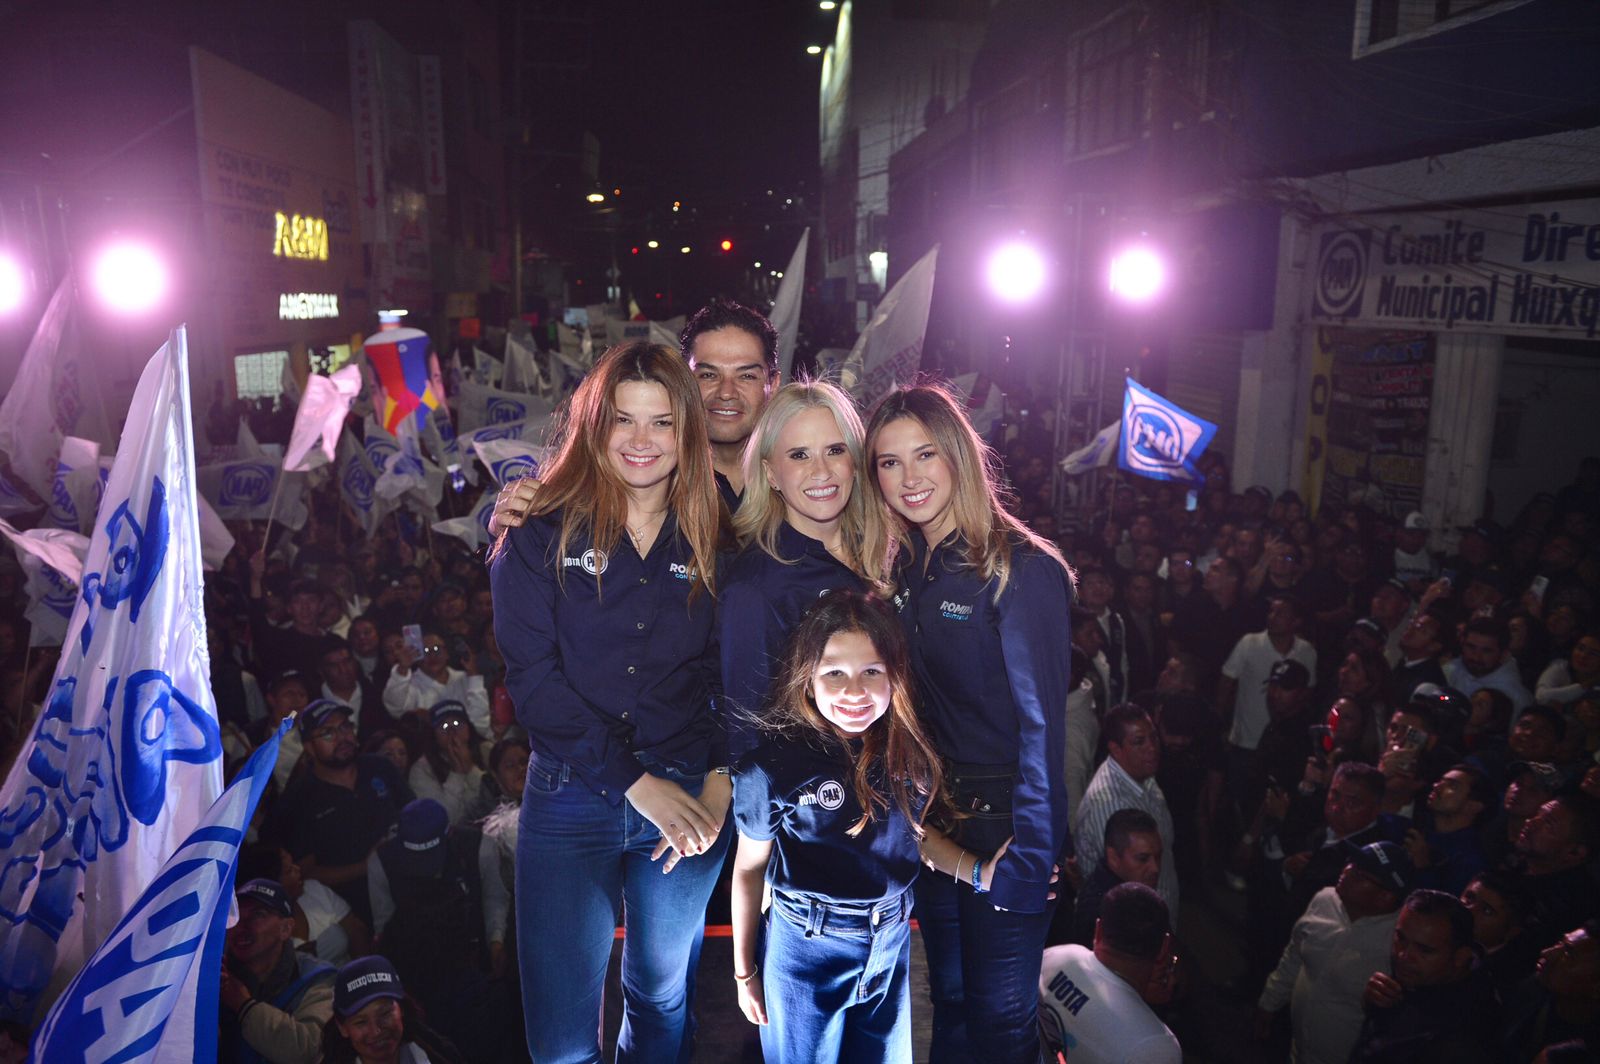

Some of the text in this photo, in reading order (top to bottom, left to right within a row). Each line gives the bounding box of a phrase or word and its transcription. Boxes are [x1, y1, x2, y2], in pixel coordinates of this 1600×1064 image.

[1382, 219, 1486, 267] Comite
[1376, 273, 1500, 329] Municipal
[493, 406, 524, 424] PAN
[798, 787, 841, 807] VOTA PAN
[1047, 970, 1090, 1017] VOTA
